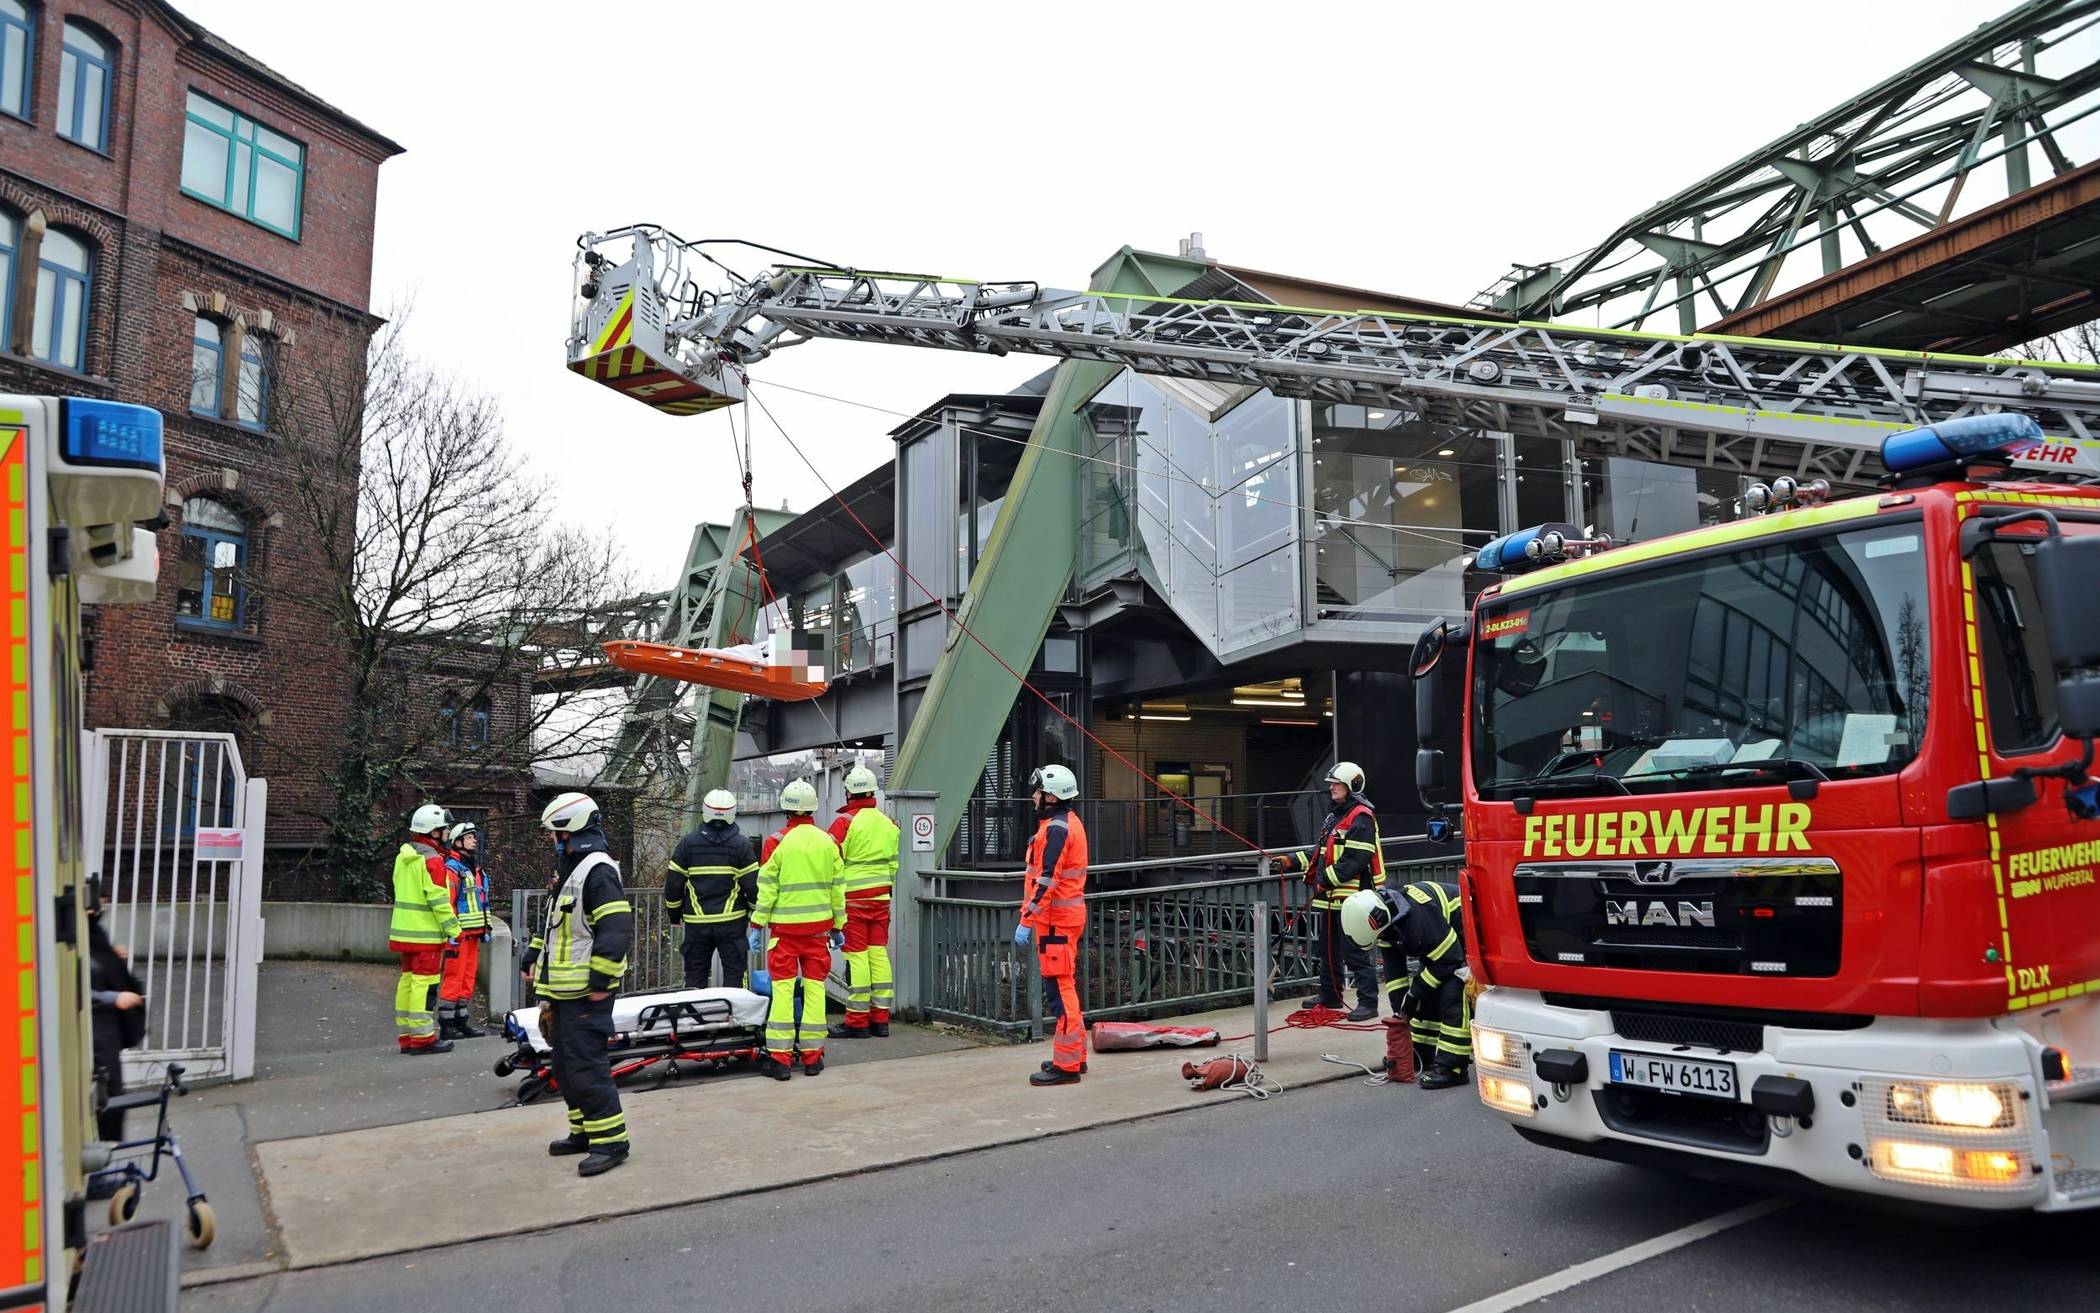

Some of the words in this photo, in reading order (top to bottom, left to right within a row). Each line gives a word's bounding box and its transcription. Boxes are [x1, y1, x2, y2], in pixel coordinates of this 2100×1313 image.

[2013, 444, 2077, 464] EHR
[1523, 802, 1812, 857] FEUERWEHR
[2043, 869, 2095, 891] WUPPERTAL
[1606, 901, 1715, 927] MAN
[1623, 1058, 1635, 1080] W
[1648, 1061, 1674, 1085] FW
[1680, 1065, 1731, 1092] 6113
